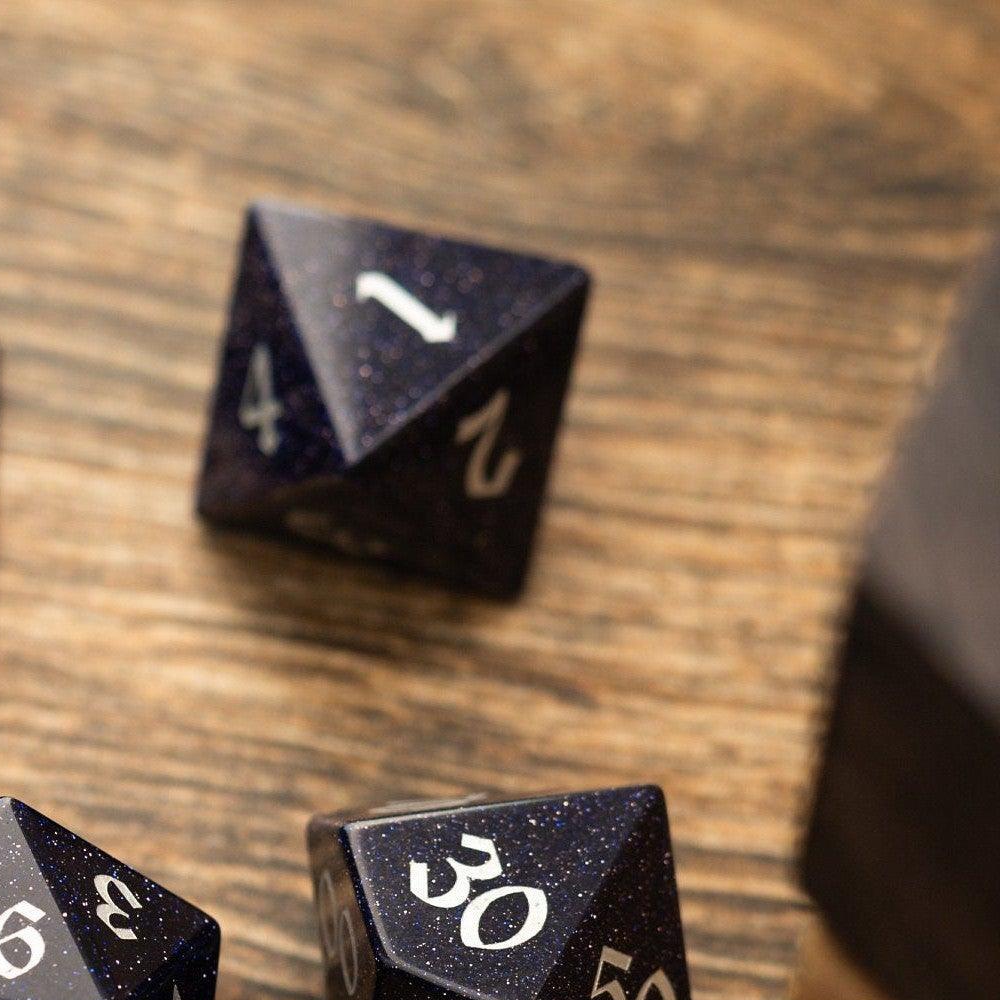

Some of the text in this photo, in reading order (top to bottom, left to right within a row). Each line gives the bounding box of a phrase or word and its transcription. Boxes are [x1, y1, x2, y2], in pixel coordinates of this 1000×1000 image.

[355, 271, 456, 343] 1
[238, 342, 285, 457] 4
[456, 391, 523, 498] 2
[93, 874, 143, 941] 3
[409, 833, 548, 950] 30
